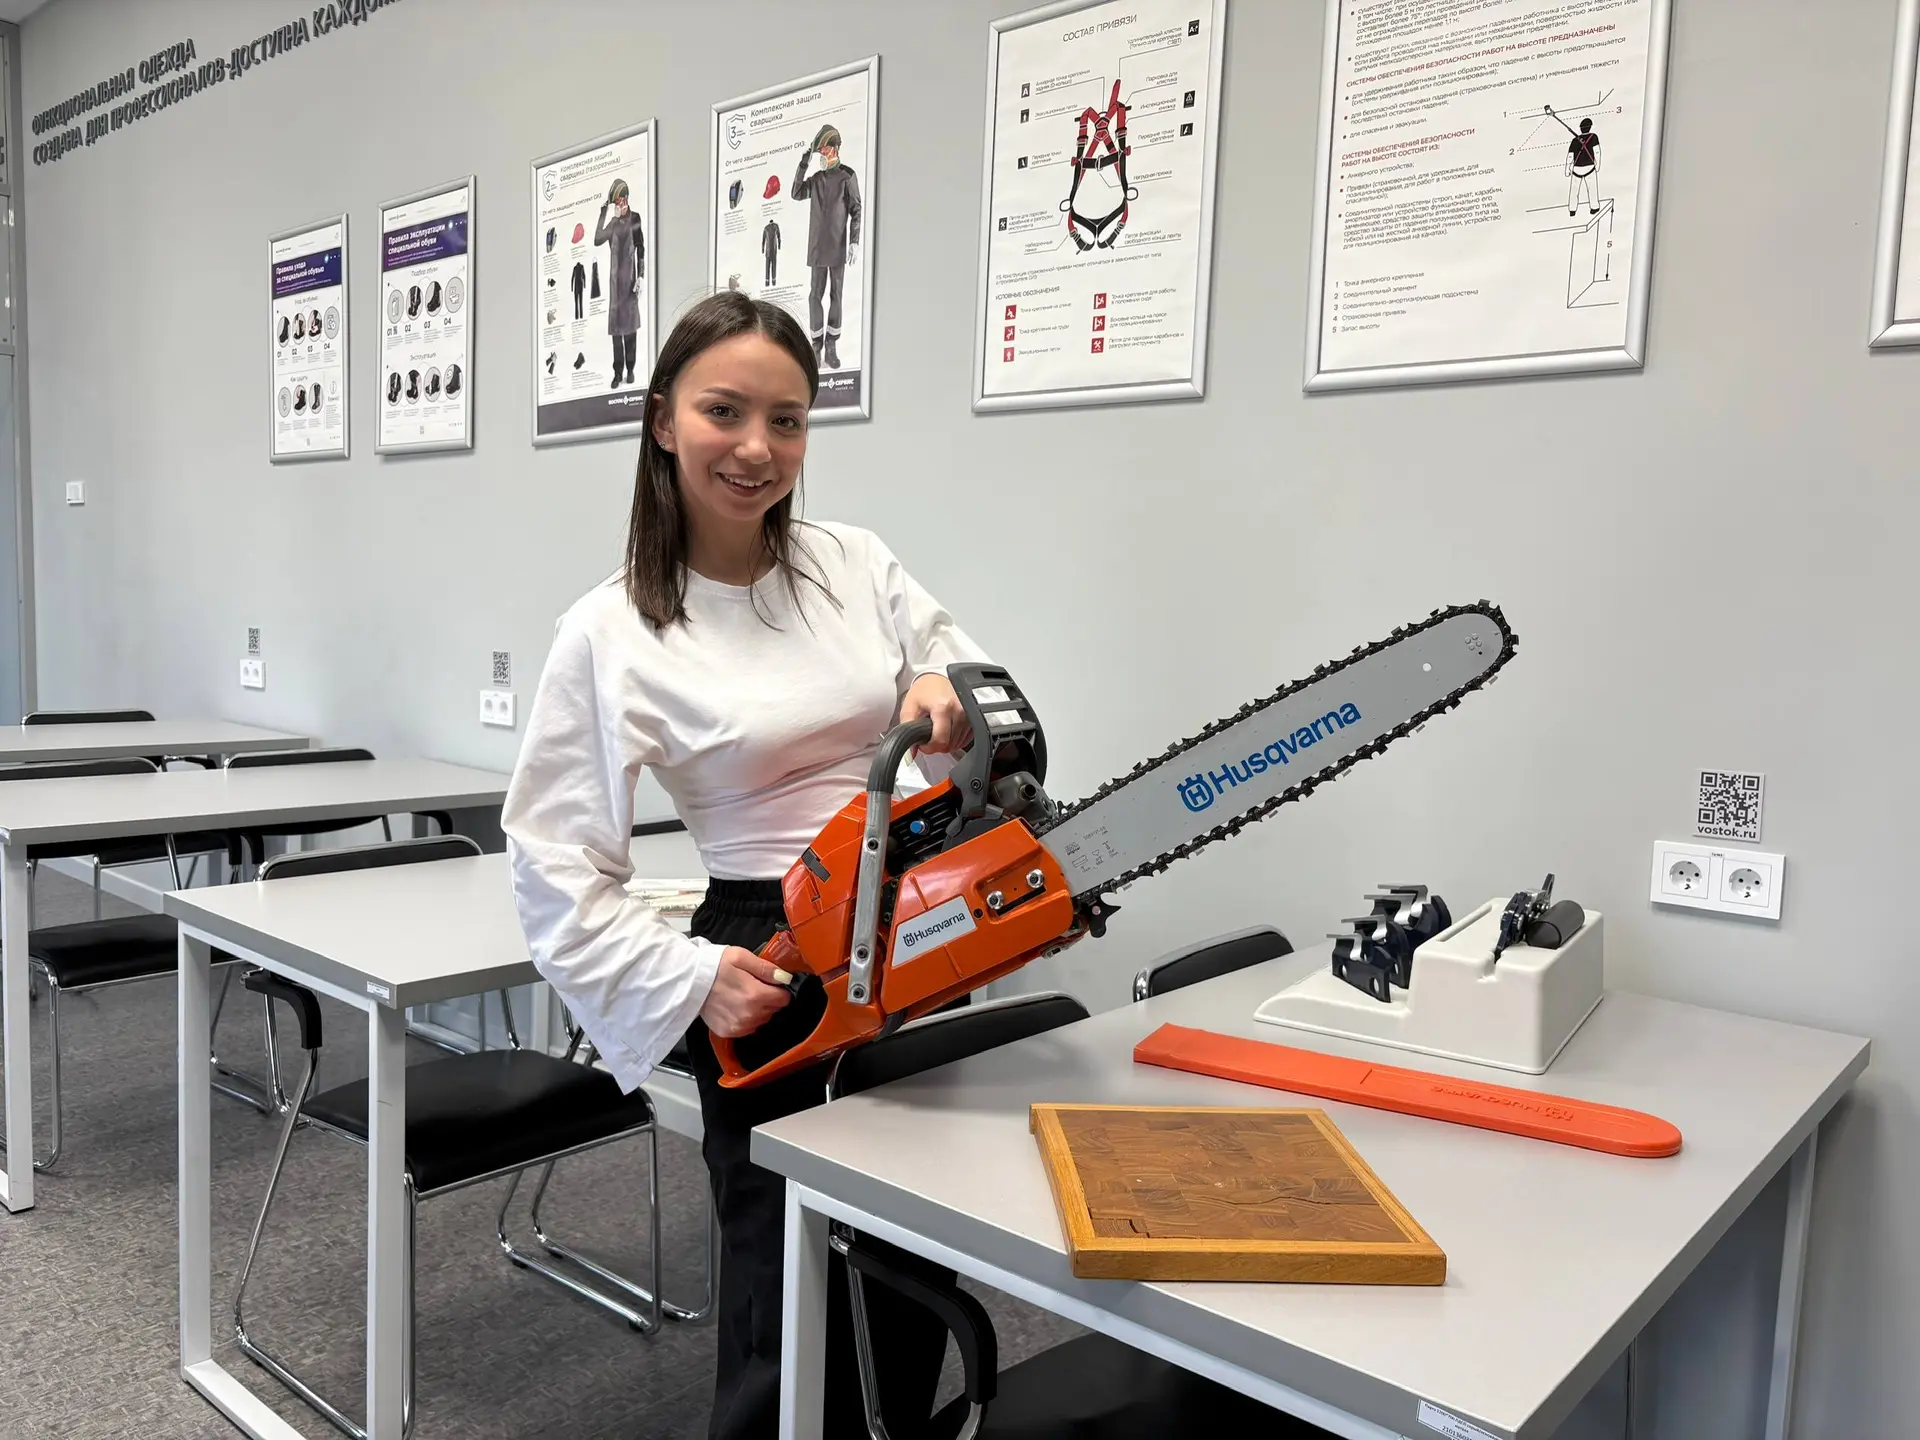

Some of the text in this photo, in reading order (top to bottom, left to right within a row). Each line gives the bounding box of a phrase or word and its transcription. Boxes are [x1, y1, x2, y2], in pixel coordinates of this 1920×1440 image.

[1062, 14, 1137, 42] СОСТАВ ПРИВЯЗИ
[1346, 23, 1615, 87] СИСТЕМЫ ОБЕСПЕЧЕНИЯ БЕЗОПАСНОСТИ РАБОТ НА ВЫСОТЕ ПРЕДНАЗНАЧЕНЫ
[1352, 92, 1363, 100] для
[1363, 83, 1403, 97] удерживания
[1403, 74, 1436, 88] работника
[1437, 71, 1456, 79] таким
[1500, 55, 1529, 67] падение
[1536, 49, 1562, 59] высоты
[32, 38, 197, 136] ФУНКЦИОНАЛЬНАЯ ОДЕЖДА
[1362, 102, 1397, 115] безопасной
[1398, 96, 1430, 108] остановки
[1431, 90, 1458, 102] падения
[1507, 73, 1537, 86] система)
[1545, 64, 1588, 78] уменьшения
[1590, 58, 1619, 68] тяжести
[750, 92, 821, 117] Комплексная защита
[1616, 106, 1622, 114] 3
[749, 113, 782, 129] сварщика
[1502, 111, 1508, 119] 1
[33, 126, 83, 166] СОЗДАНА
[85, 113, 109, 147] ДЛЯ
[730, 122, 737, 139] 3
[743, 151, 768, 163] защищает
[769, 144, 792, 155] комплект
[1341, 128, 1475, 160] СИСТЕМЫ ОБЕСПЕЧЕНИЯ БЕЗОПАСНОСТИ
[1508, 147, 1515, 156] 2
[560, 151, 612, 172] Комплексная защита
[1341, 159, 1360, 168] РАБОТ
[1371, 152, 1396, 162] ВЫСОТЕ
[1397, 146, 1427, 157] СОСТОЯТ
[1347, 167, 1378, 179] Анкерного
[545, 181, 552, 192] 2
[388, 223, 445, 245] Правила эксплуатации
[388, 235, 436, 255] специальной обуви
[1606, 240, 1613, 249] 5
[276, 261, 305, 275] Правила ухода
[281, 269, 307, 283] специальной
[307, 264, 324, 276] обувью
[404, 324, 411, 333] 02
[424, 321, 431, 329] 03
[444, 318, 451, 326] 04
[1209, 702, 1362, 794] Husqvarna
[1697, 825, 1757, 839] vostok.ru
[914, 912, 966, 941] Husqvarna
